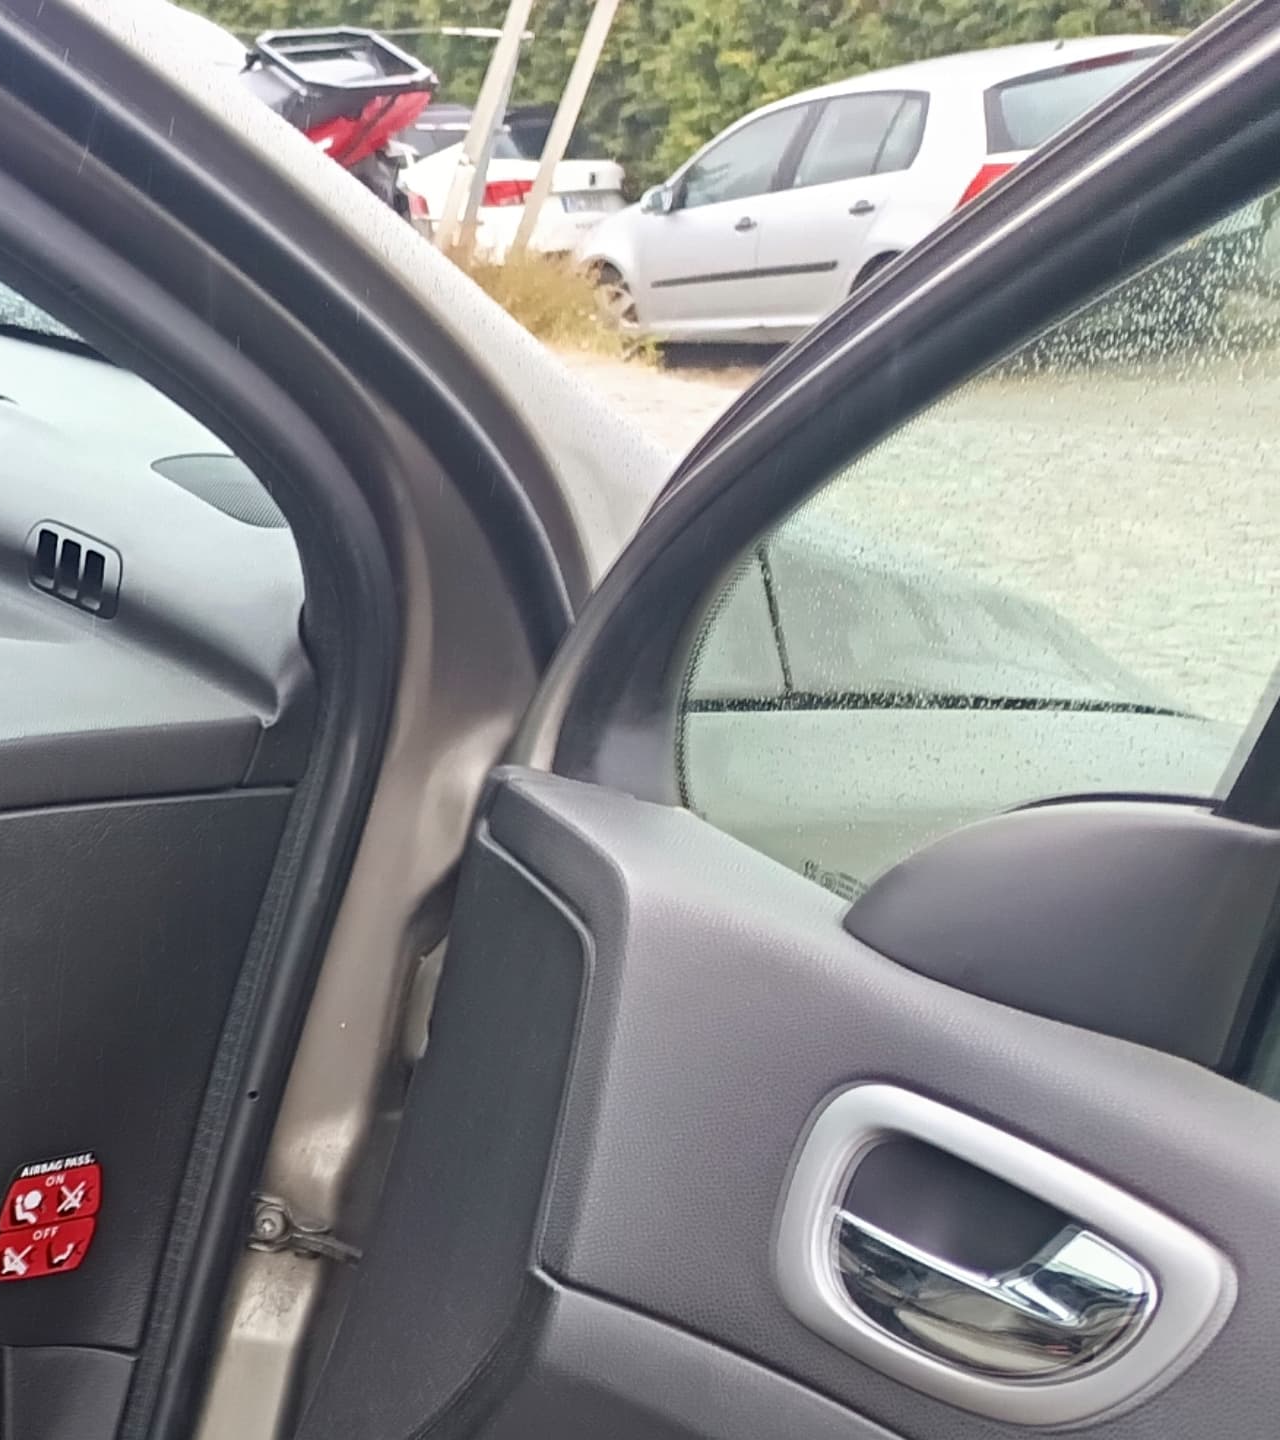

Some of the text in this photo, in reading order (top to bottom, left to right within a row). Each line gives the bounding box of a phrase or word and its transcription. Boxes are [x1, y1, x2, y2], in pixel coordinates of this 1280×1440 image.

[21, 1153, 95, 1177] AIRBAG PASS.
[45, 1174, 65, 1187] ON
[32, 1225, 59, 1241] OFF
